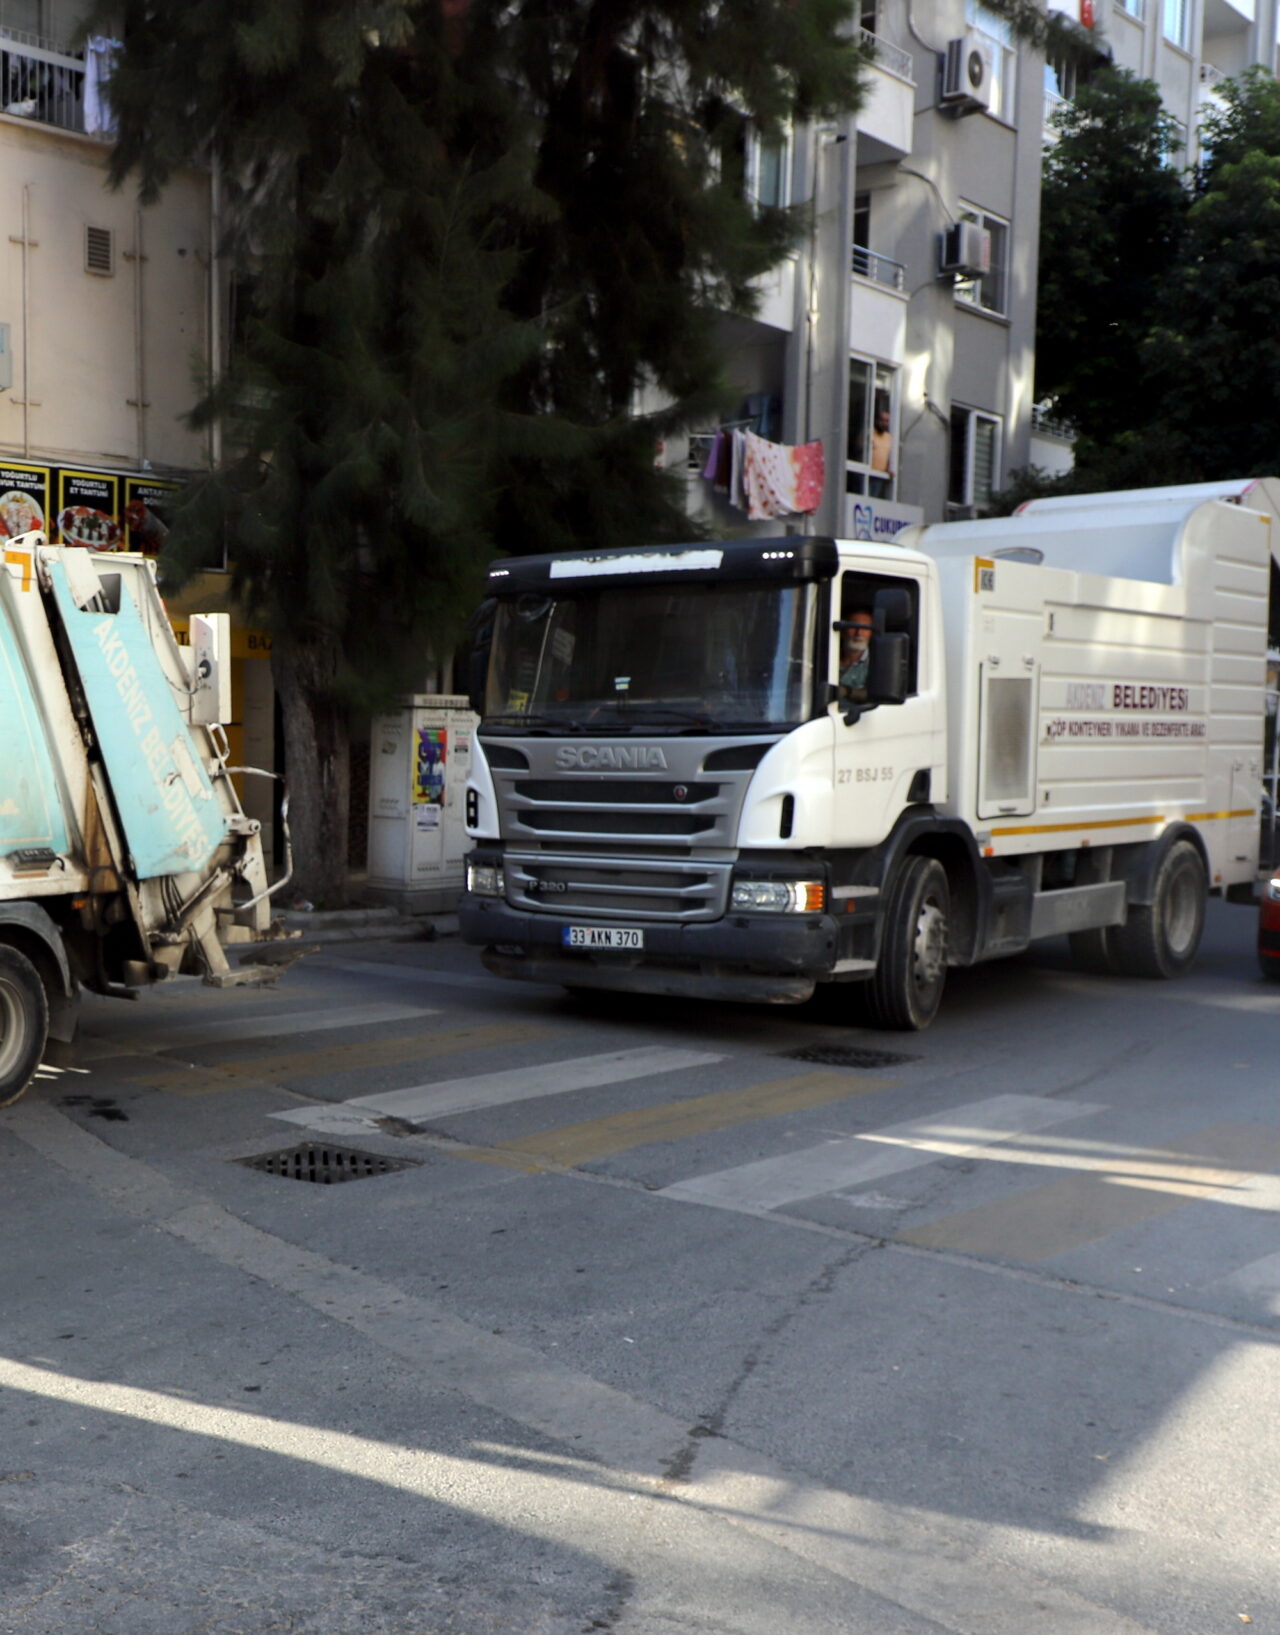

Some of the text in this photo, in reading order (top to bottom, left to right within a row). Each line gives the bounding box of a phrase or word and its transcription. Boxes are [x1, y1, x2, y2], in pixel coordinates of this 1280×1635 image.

[0, 471, 38, 482] YOĞURTLU
[71, 479, 107, 490] YOĞURTLU
[70, 486, 80, 494] ET
[1113, 684, 1189, 710] BELEDİYESİ
[1142, 721, 1150, 737] VE
[555, 746, 669, 770] SCANIA
[837, 766, 894, 784] 27 BSJ 55
[529, 880, 566, 893] P 320
[572, 928, 639, 946] 33 AKN 370
